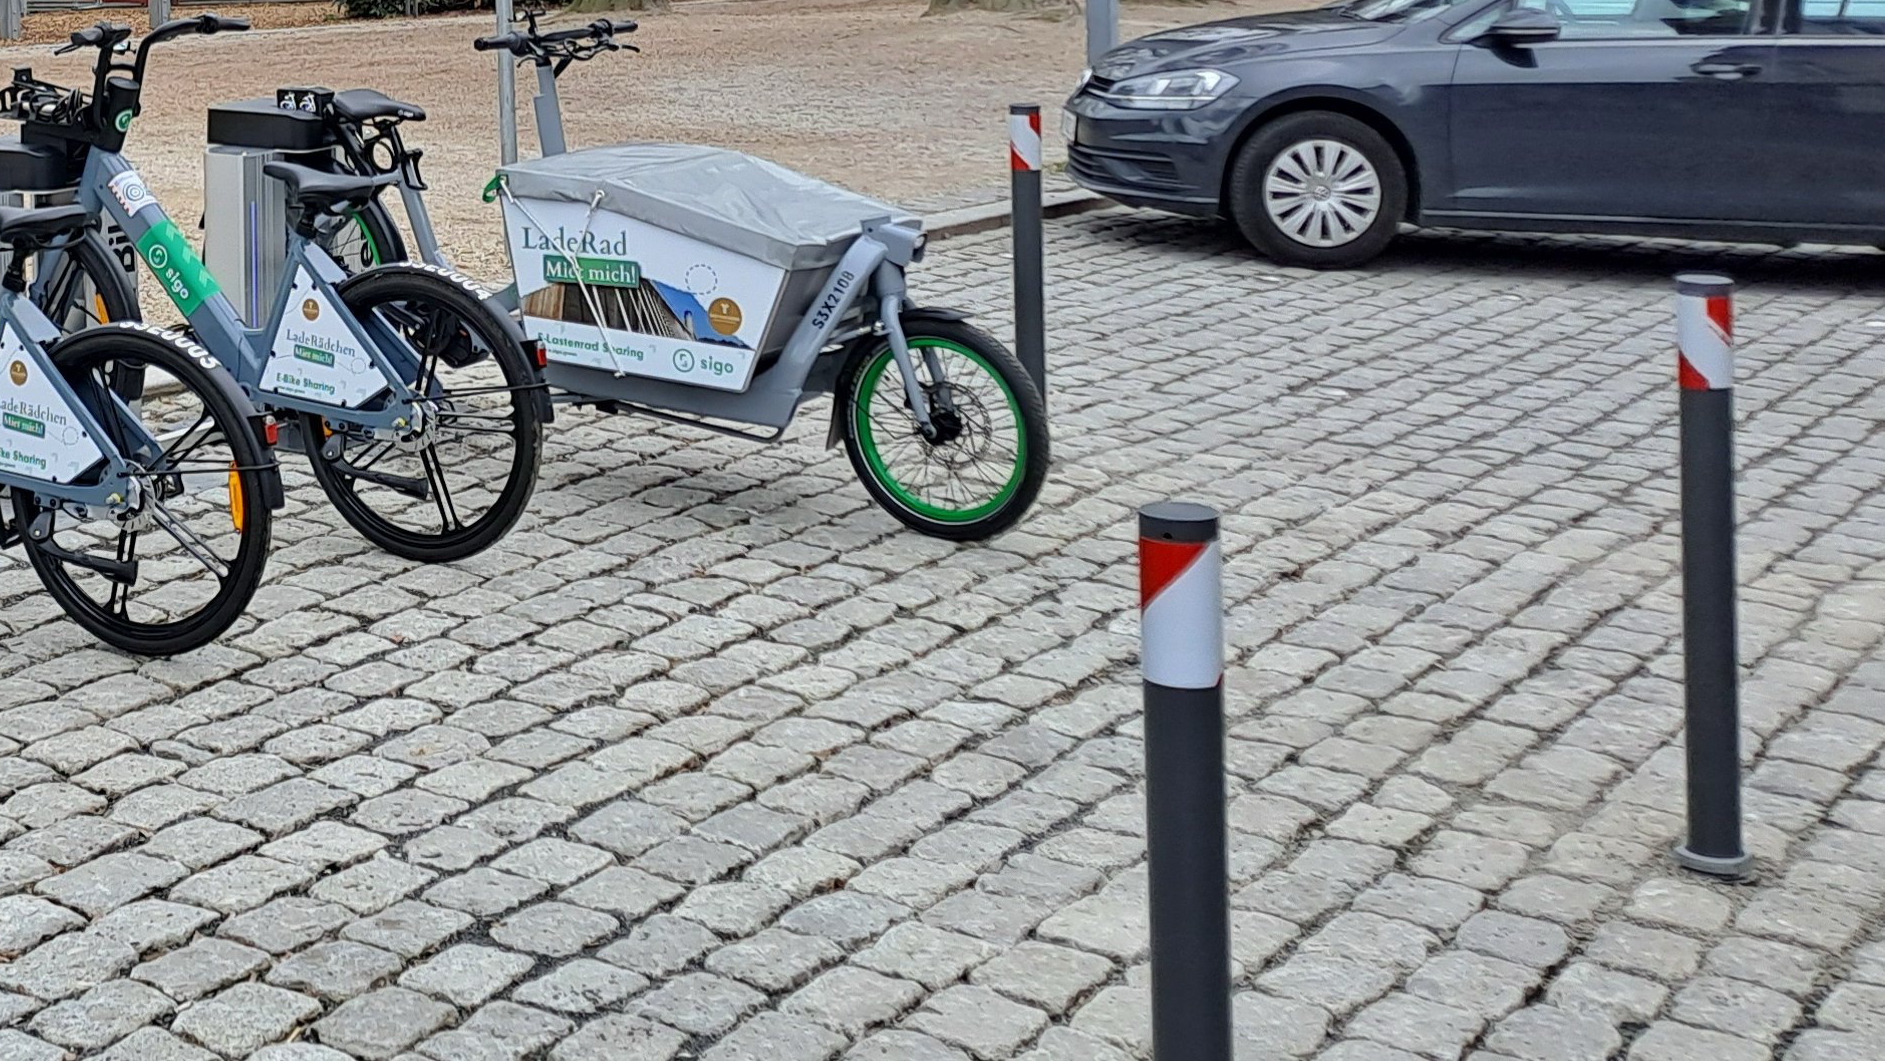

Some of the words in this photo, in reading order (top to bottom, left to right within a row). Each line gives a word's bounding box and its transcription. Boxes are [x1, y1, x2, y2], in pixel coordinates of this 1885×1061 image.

[521, 226, 627, 257] LadeRad
[165, 268, 189, 299] sigo
[588, 263, 636, 284] mich!
[811, 271, 855, 330] S3X2108
[286, 328, 356, 357] LadeRädchen
[537, 332, 599, 352] E-Lastenrad
[699, 354, 734, 376] sigo
[276, 372, 301, 386] E-Bike
[303, 377, 336, 395] Sharing
[12, 447, 47, 470] Sharing
